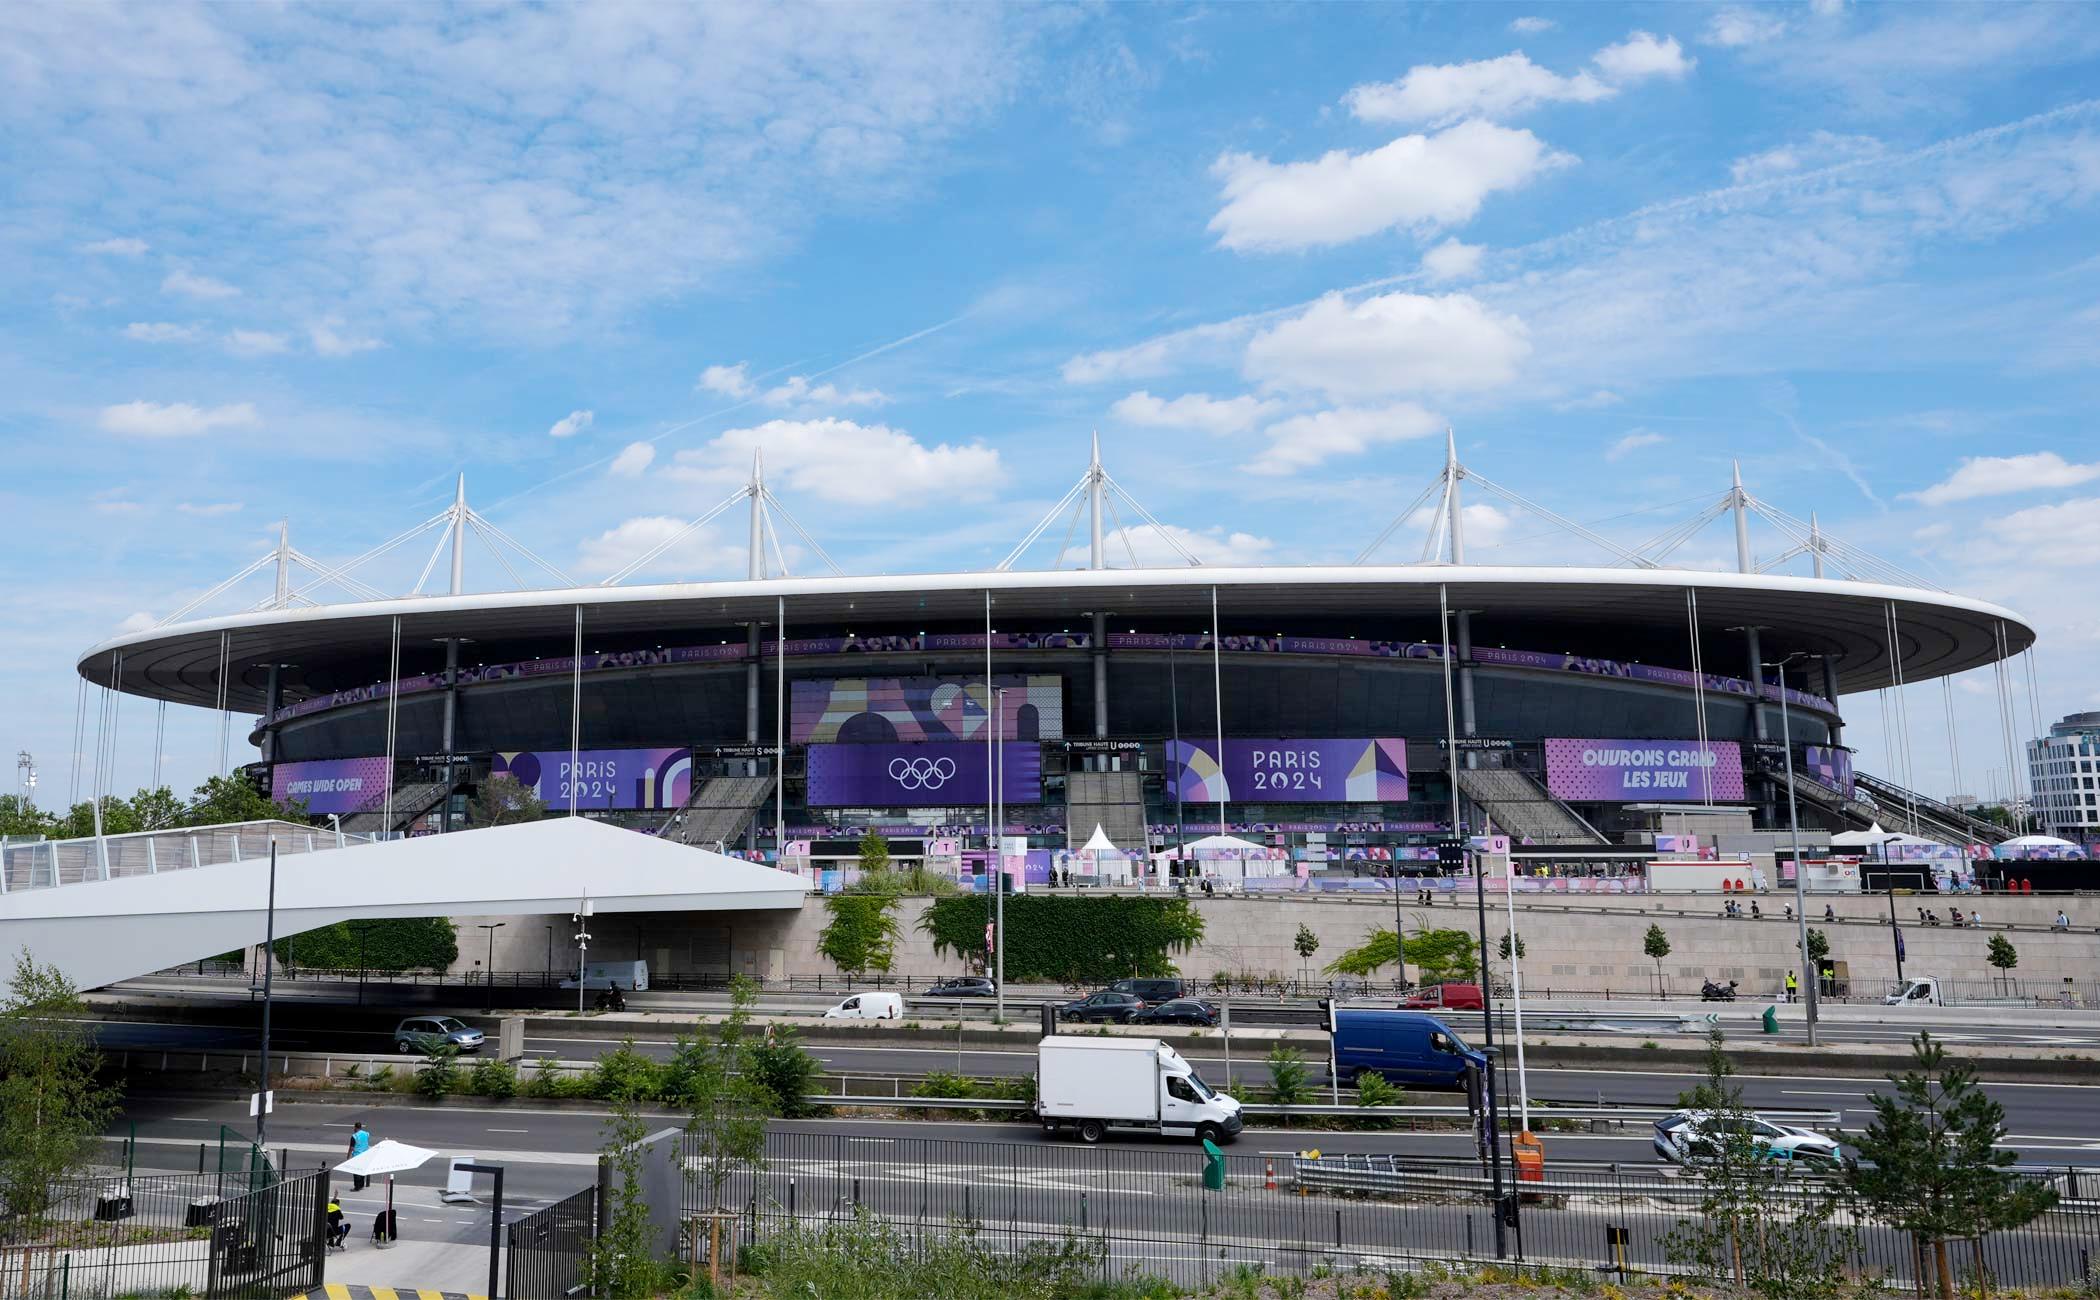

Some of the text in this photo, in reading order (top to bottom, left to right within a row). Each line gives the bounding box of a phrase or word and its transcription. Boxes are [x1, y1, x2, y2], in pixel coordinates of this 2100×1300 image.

[803, 641, 830, 651] 2024
[936, 638, 967, 646] PARIS
[1119, 637, 1151, 646] PARIS
[1293, 641, 1358, 652] PARIS 2024
[681, 647, 739, 658] PARIS 2024
[1487, 652, 1546, 665] PARIS 2024
[1110, 741, 1117, 750] U
[1483, 739, 1489, 748] U
[756, 747, 762, 756] S
[1667, 750, 1717, 767] GRAND
[1254, 772, 1321, 790] 2024
[1623, 771, 1688, 788] LES JEUX
[287, 778, 362, 794] GAMES WIDE OPEN
[798, 844, 804, 852] T
[944, 843, 949, 851] T
[1496, 840, 1502, 849] U
